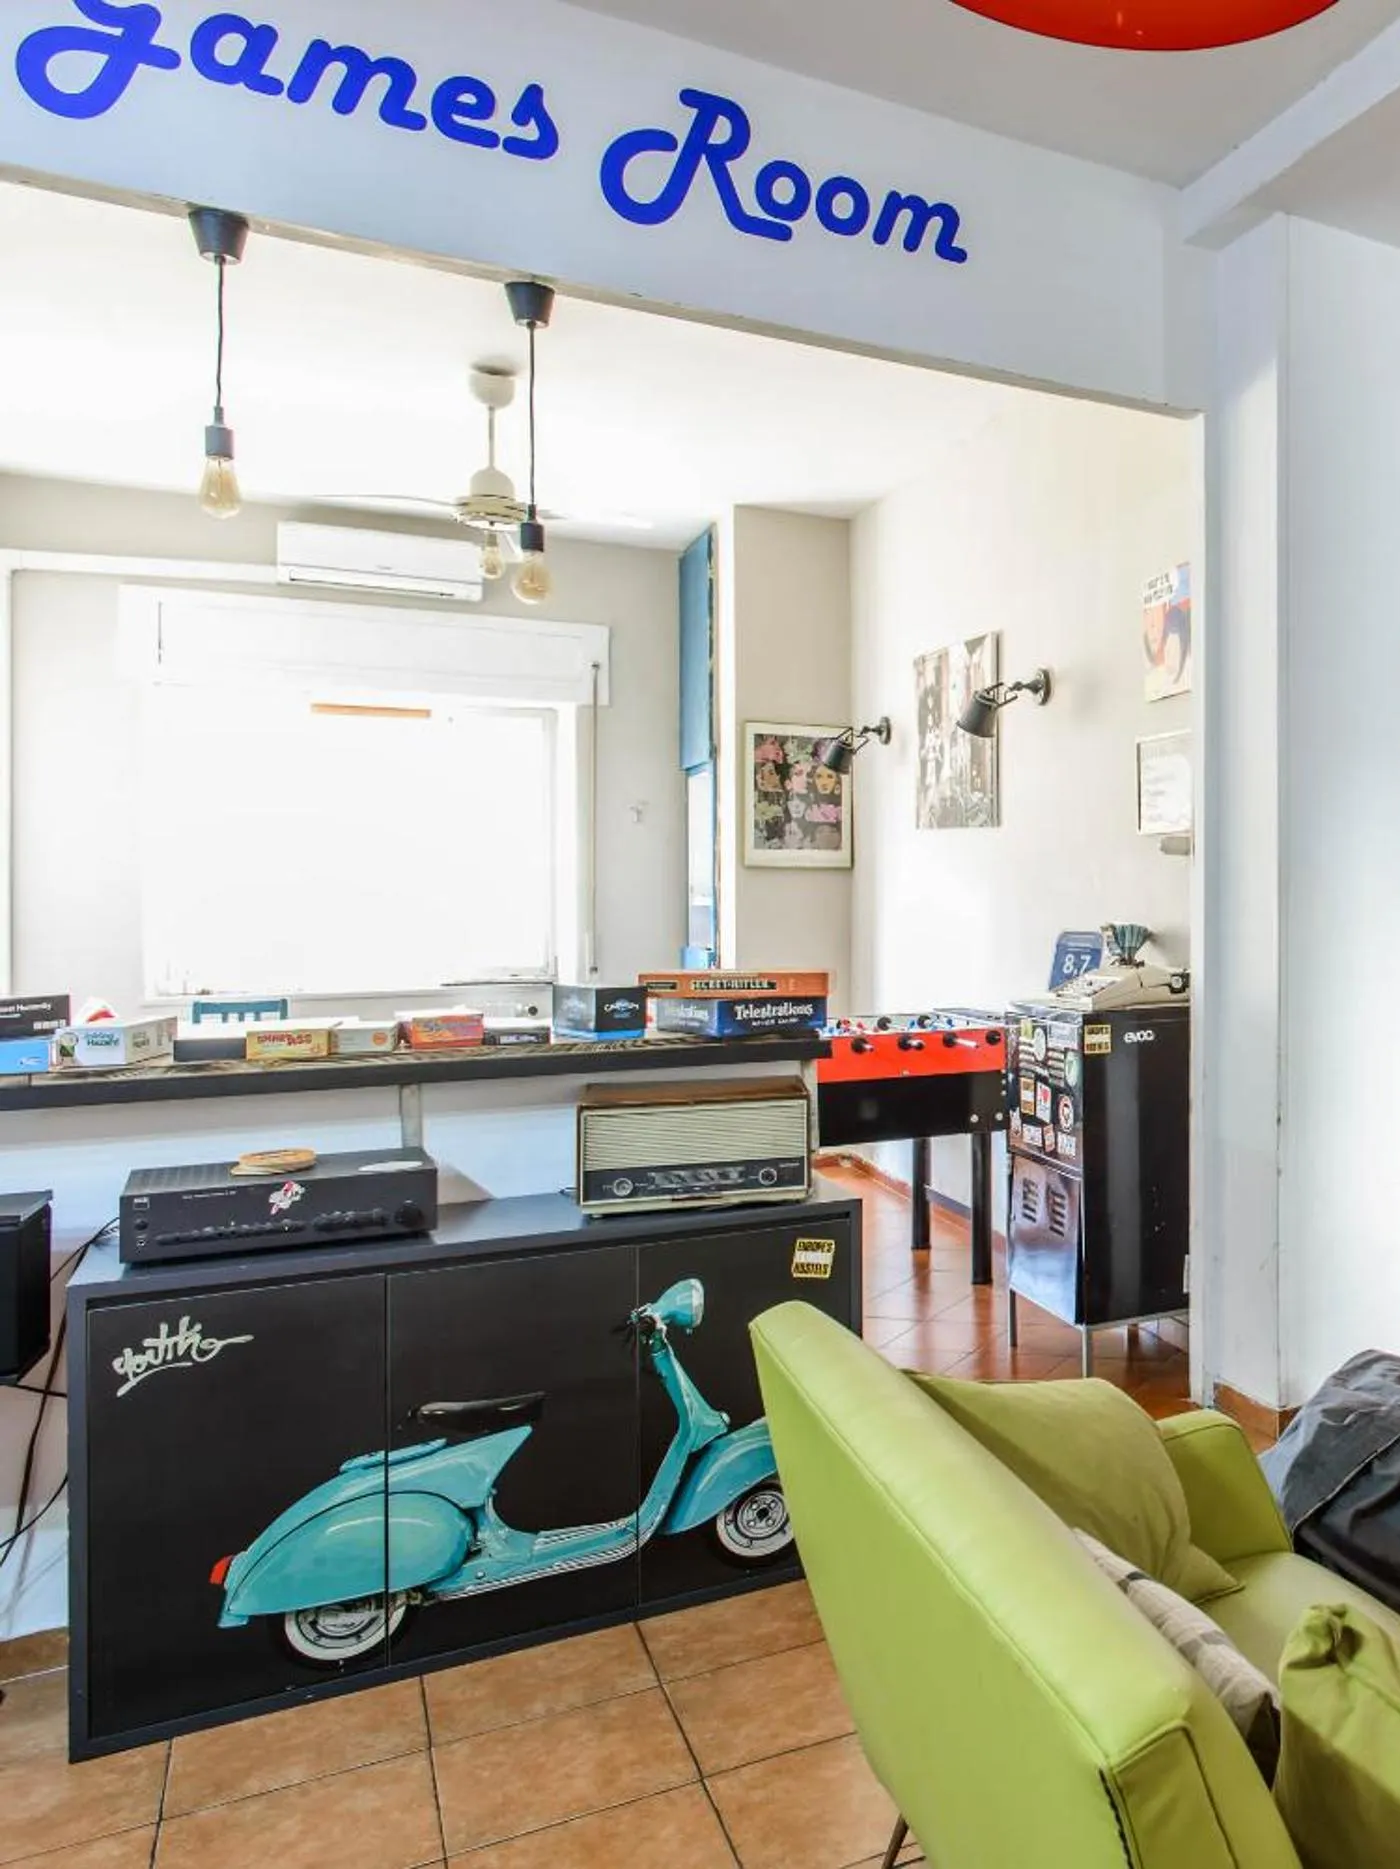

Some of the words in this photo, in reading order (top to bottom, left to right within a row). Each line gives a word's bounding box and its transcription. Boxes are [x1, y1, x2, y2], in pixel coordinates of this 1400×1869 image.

[15, 0, 560, 161] Games
[600, 88, 968, 263] Room
[733, 1001, 814, 1021] Telestrations
